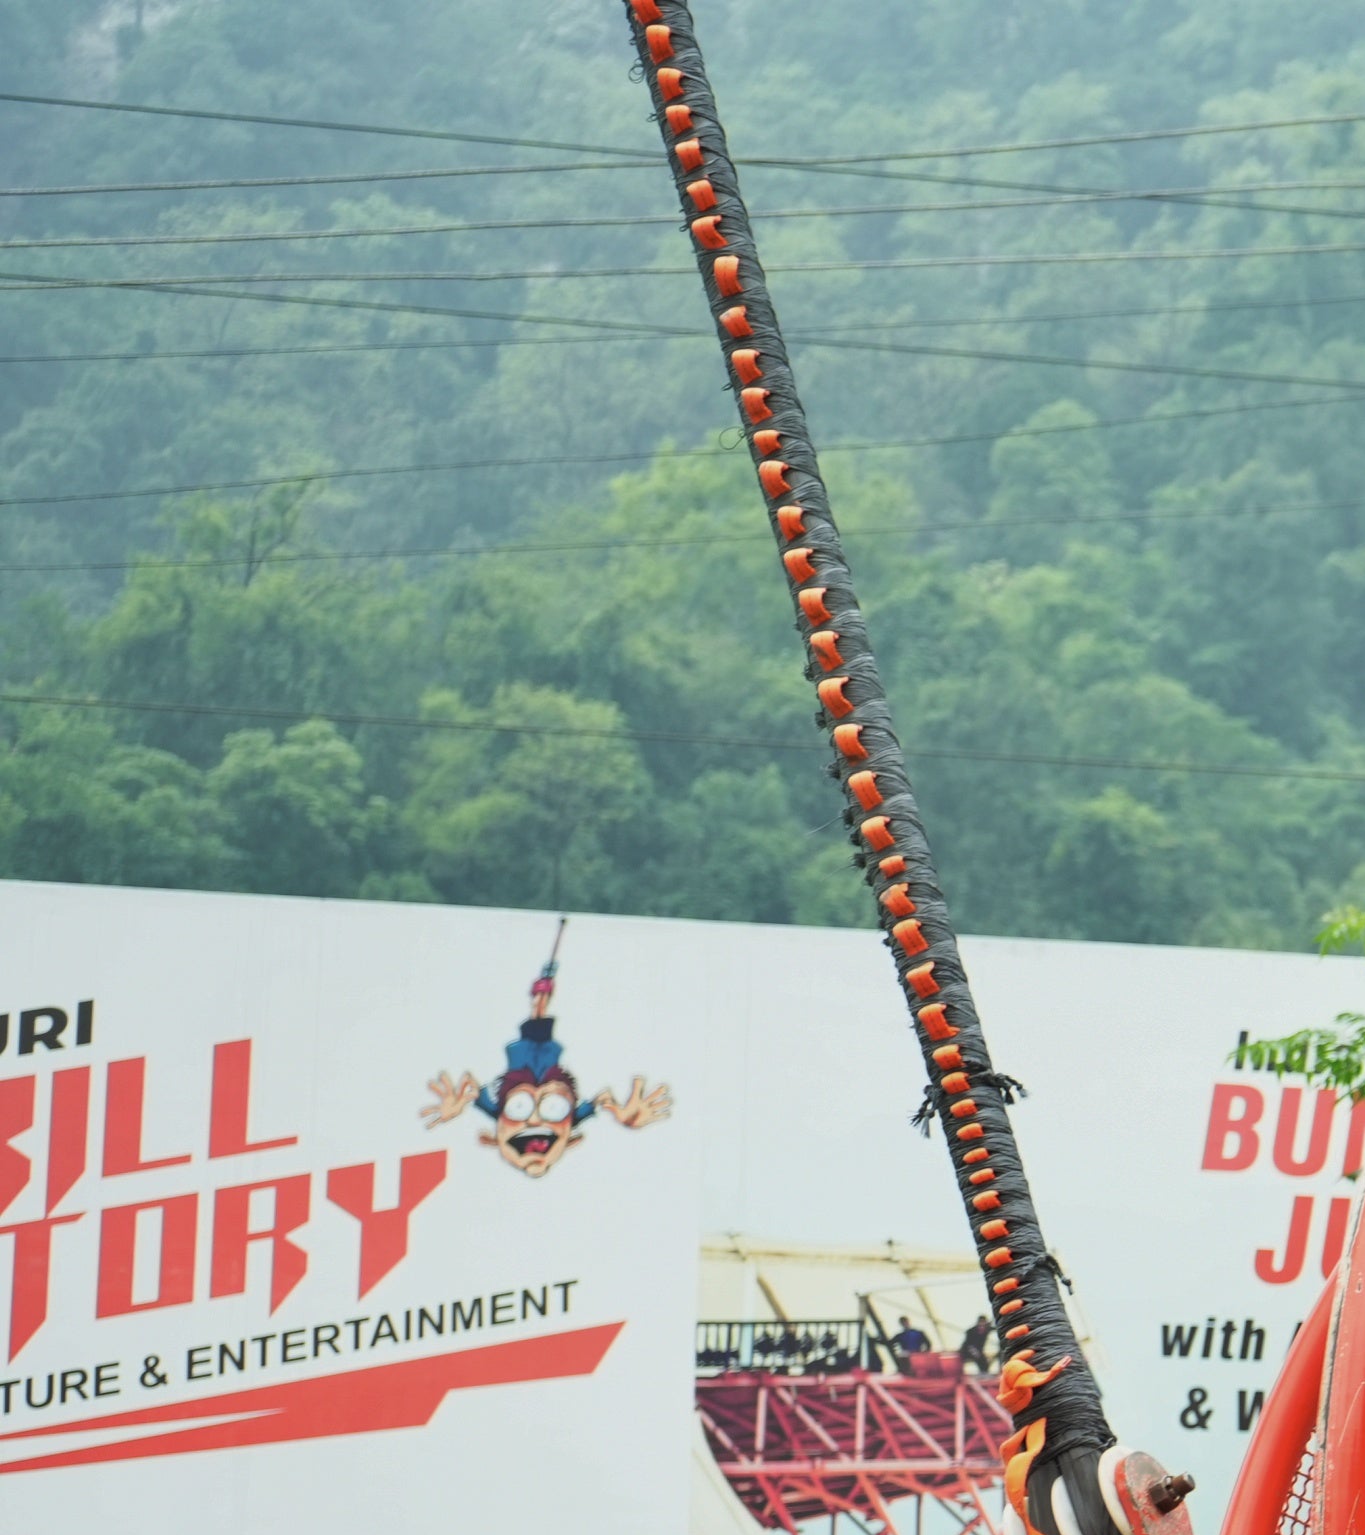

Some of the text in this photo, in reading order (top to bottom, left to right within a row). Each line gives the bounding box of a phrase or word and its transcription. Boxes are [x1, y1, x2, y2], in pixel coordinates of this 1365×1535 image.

[0, 998, 94, 1056] RI
[139, 1354, 169, 1388] &
[187, 1280, 580, 1381] ENTERTAINMENT
[1161, 1318, 1266, 1361] with
[1179, 1387, 1214, 1430] &
